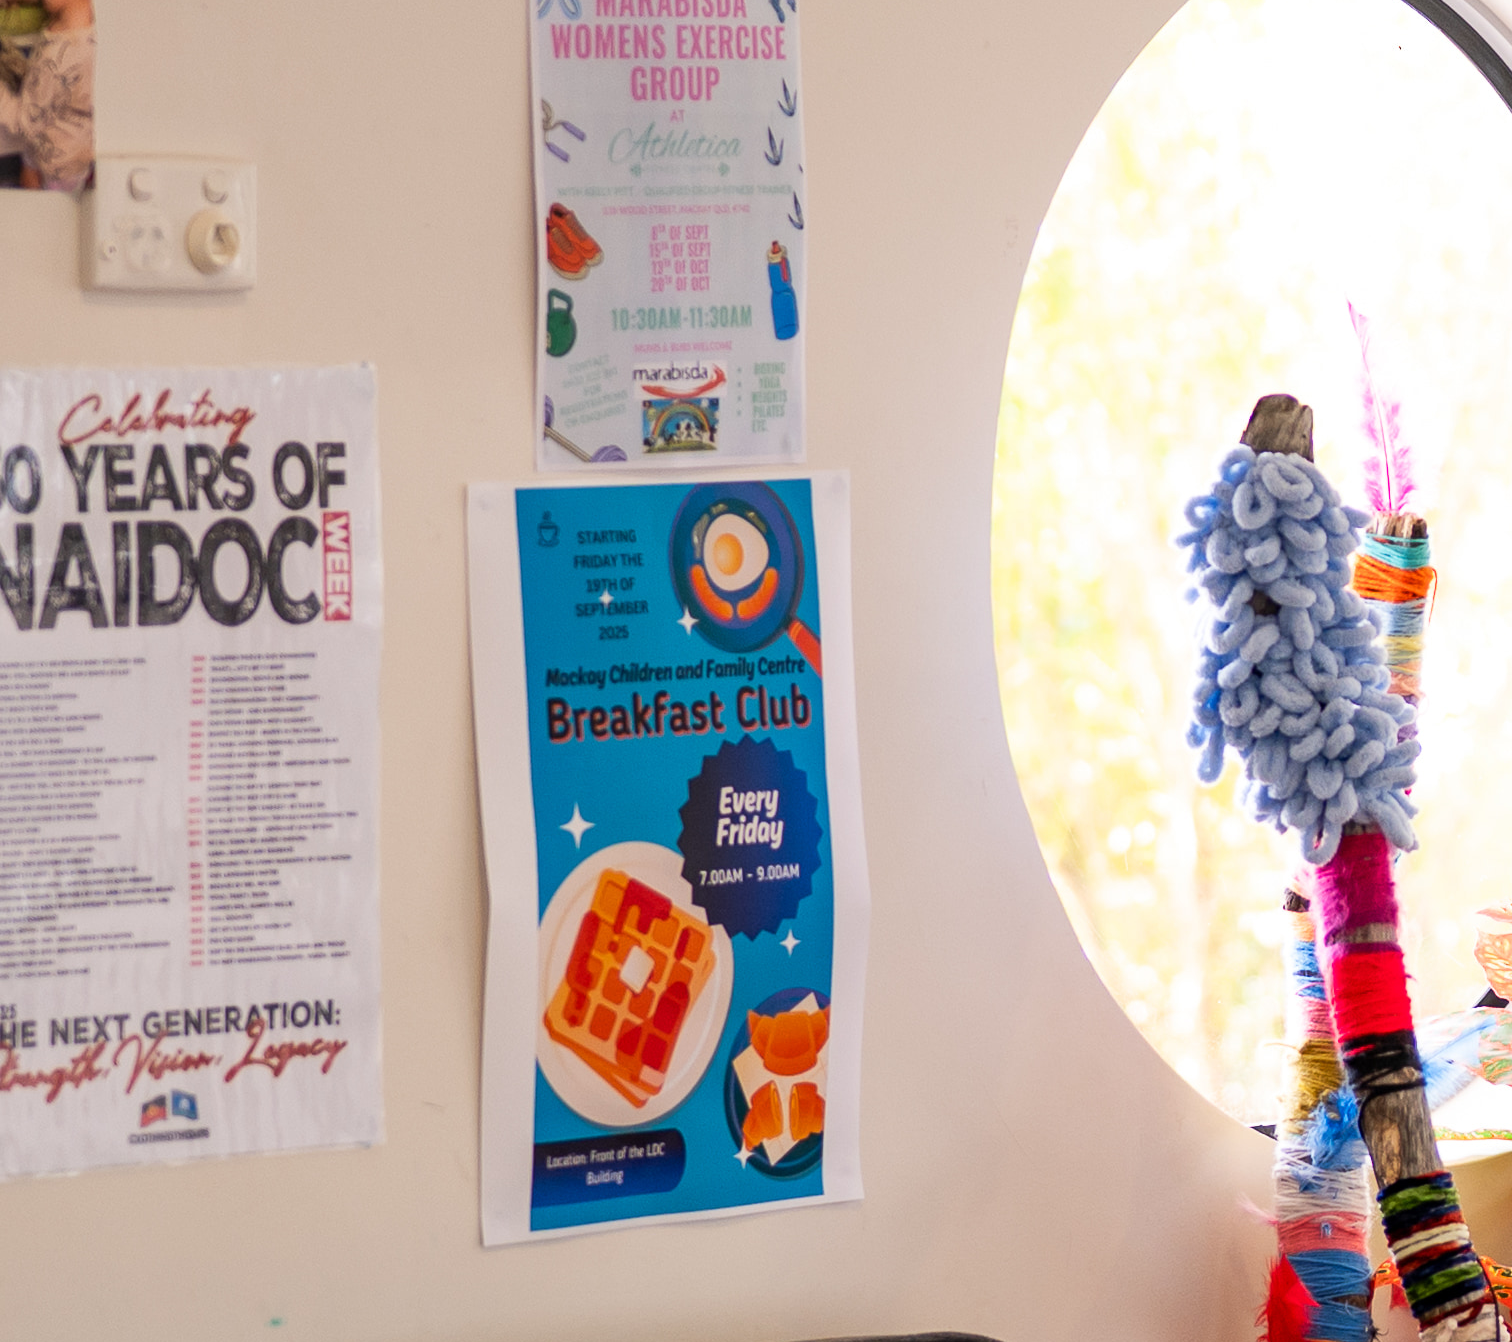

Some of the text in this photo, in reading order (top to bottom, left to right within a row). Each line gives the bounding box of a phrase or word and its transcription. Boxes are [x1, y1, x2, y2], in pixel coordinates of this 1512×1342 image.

[550, 23, 787, 60] WOMENS EXERCISE
[630, 65, 721, 102] GROUP
[670, 110, 685, 123] AT
[607, 121, 742, 165] Athletica
[632, 361, 709, 381] marabisda
[58, 388, 257, 446] Celebrating
[60, 444, 255, 513] YEARS
[272, 441, 347, 511] OF
[577, 528, 637, 546] STARTING
[325, 516, 350, 613] WEEK
[573, 552, 645, 570] FRIDAY THE
[586, 577, 635, 594] 19TH OF
[575, 599, 649, 618] SEPTEMBER
[598, 625, 630, 641] 2025
[545, 655, 806, 690] Mackay Children and Family Centre
[546, 682, 812, 745] Breakfast Club
[719, 785, 780, 819] Every
[716, 816, 785, 850] Friday
[699, 863, 800, 886] 7.00AM 9.00AM
[50, 1012, 130, 1046] NEXT
[142, 998, 341, 1040] GENERATION:
[224, 1019, 348, 1083] Legacy
